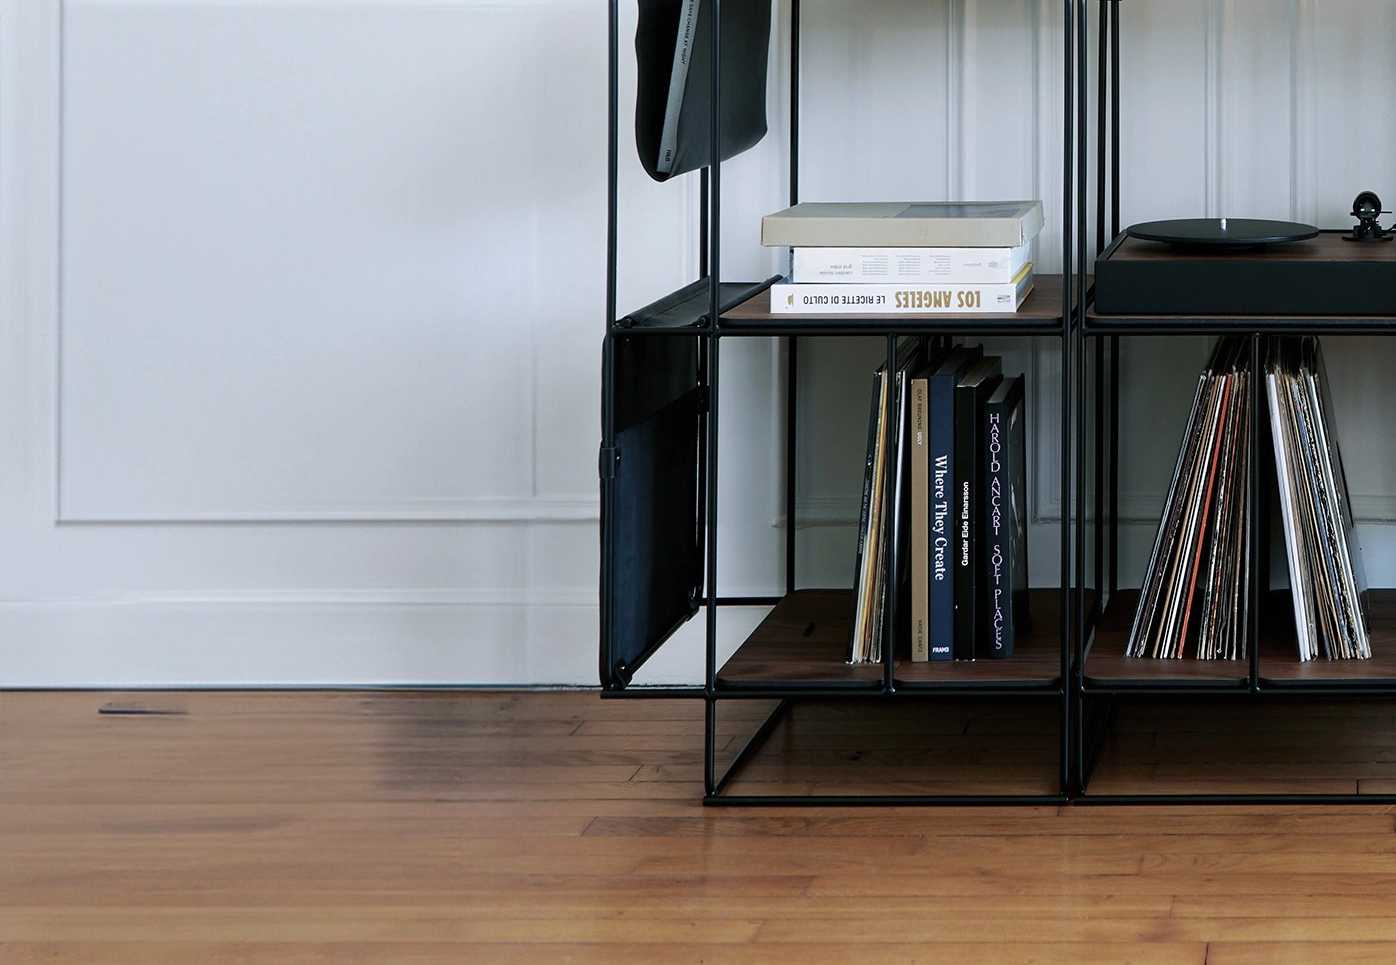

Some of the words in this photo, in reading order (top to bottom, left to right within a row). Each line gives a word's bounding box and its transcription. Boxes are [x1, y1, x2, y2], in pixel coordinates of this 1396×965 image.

[803, 295, 829, 305] CULTO
[830, 295, 840, 305] DI
[841, 295, 874, 305] RICETTE
[876, 295, 886, 304] LE
[894, 290, 952, 309] ANGELES
[957, 290, 981, 308] LOS
[989, 413, 1001, 473] HAROLD
[935, 454, 948, 499] Where
[961, 481, 969, 520] Einarsson
[991, 476, 1001, 536] ANCART
[932, 501, 948, 535] They
[961, 521, 969, 538] Eide
[934, 537, 948, 581] Create
[961, 539, 969, 567] Gardar
[991, 544, 1003, 585] SOFT
[994, 588, 1003, 650] PLACES
